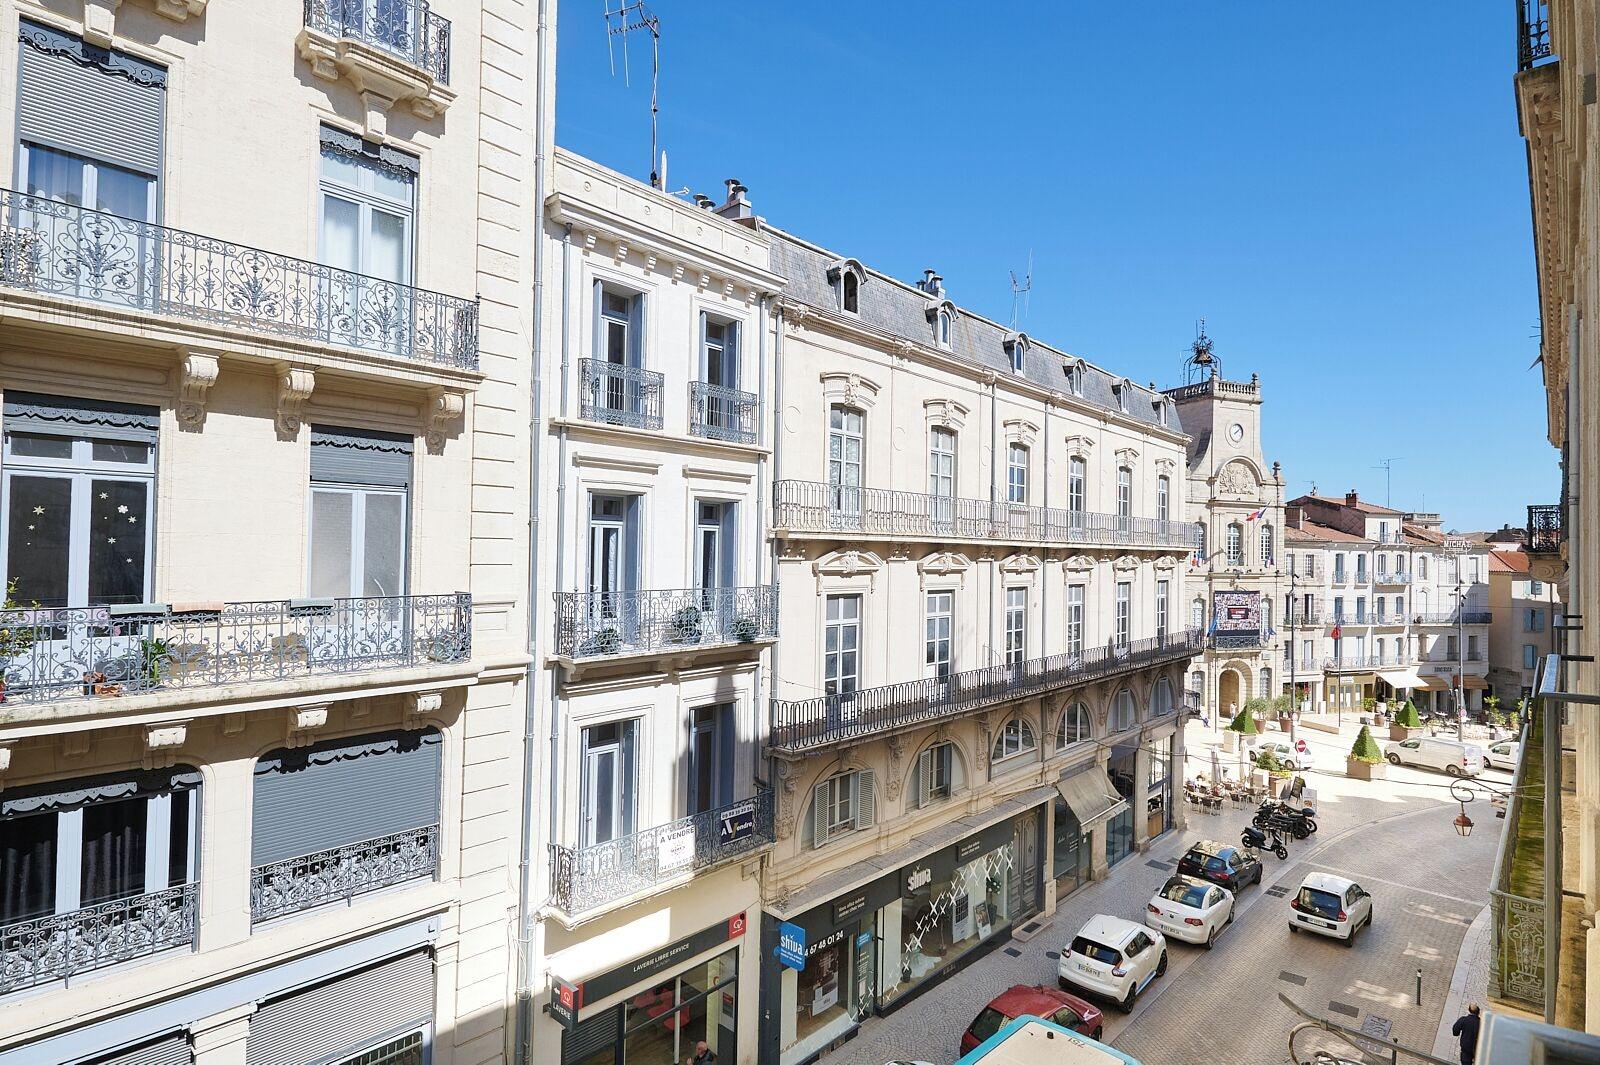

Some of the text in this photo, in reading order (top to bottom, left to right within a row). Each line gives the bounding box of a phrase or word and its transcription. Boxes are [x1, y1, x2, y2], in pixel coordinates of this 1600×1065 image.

[667, 827, 695, 841] VENDRE
[721, 828, 727, 836] A
[809, 942, 818, 954] 67
[827, 934, 835, 945] 01
[836, 930, 844, 941] 24
[633, 956, 655, 973] LAVERIE
[654, 952, 670, 964] LIBRE
[669, 943, 690, 957] SERVICE
[552, 1002, 571, 1020] LAVERIE
